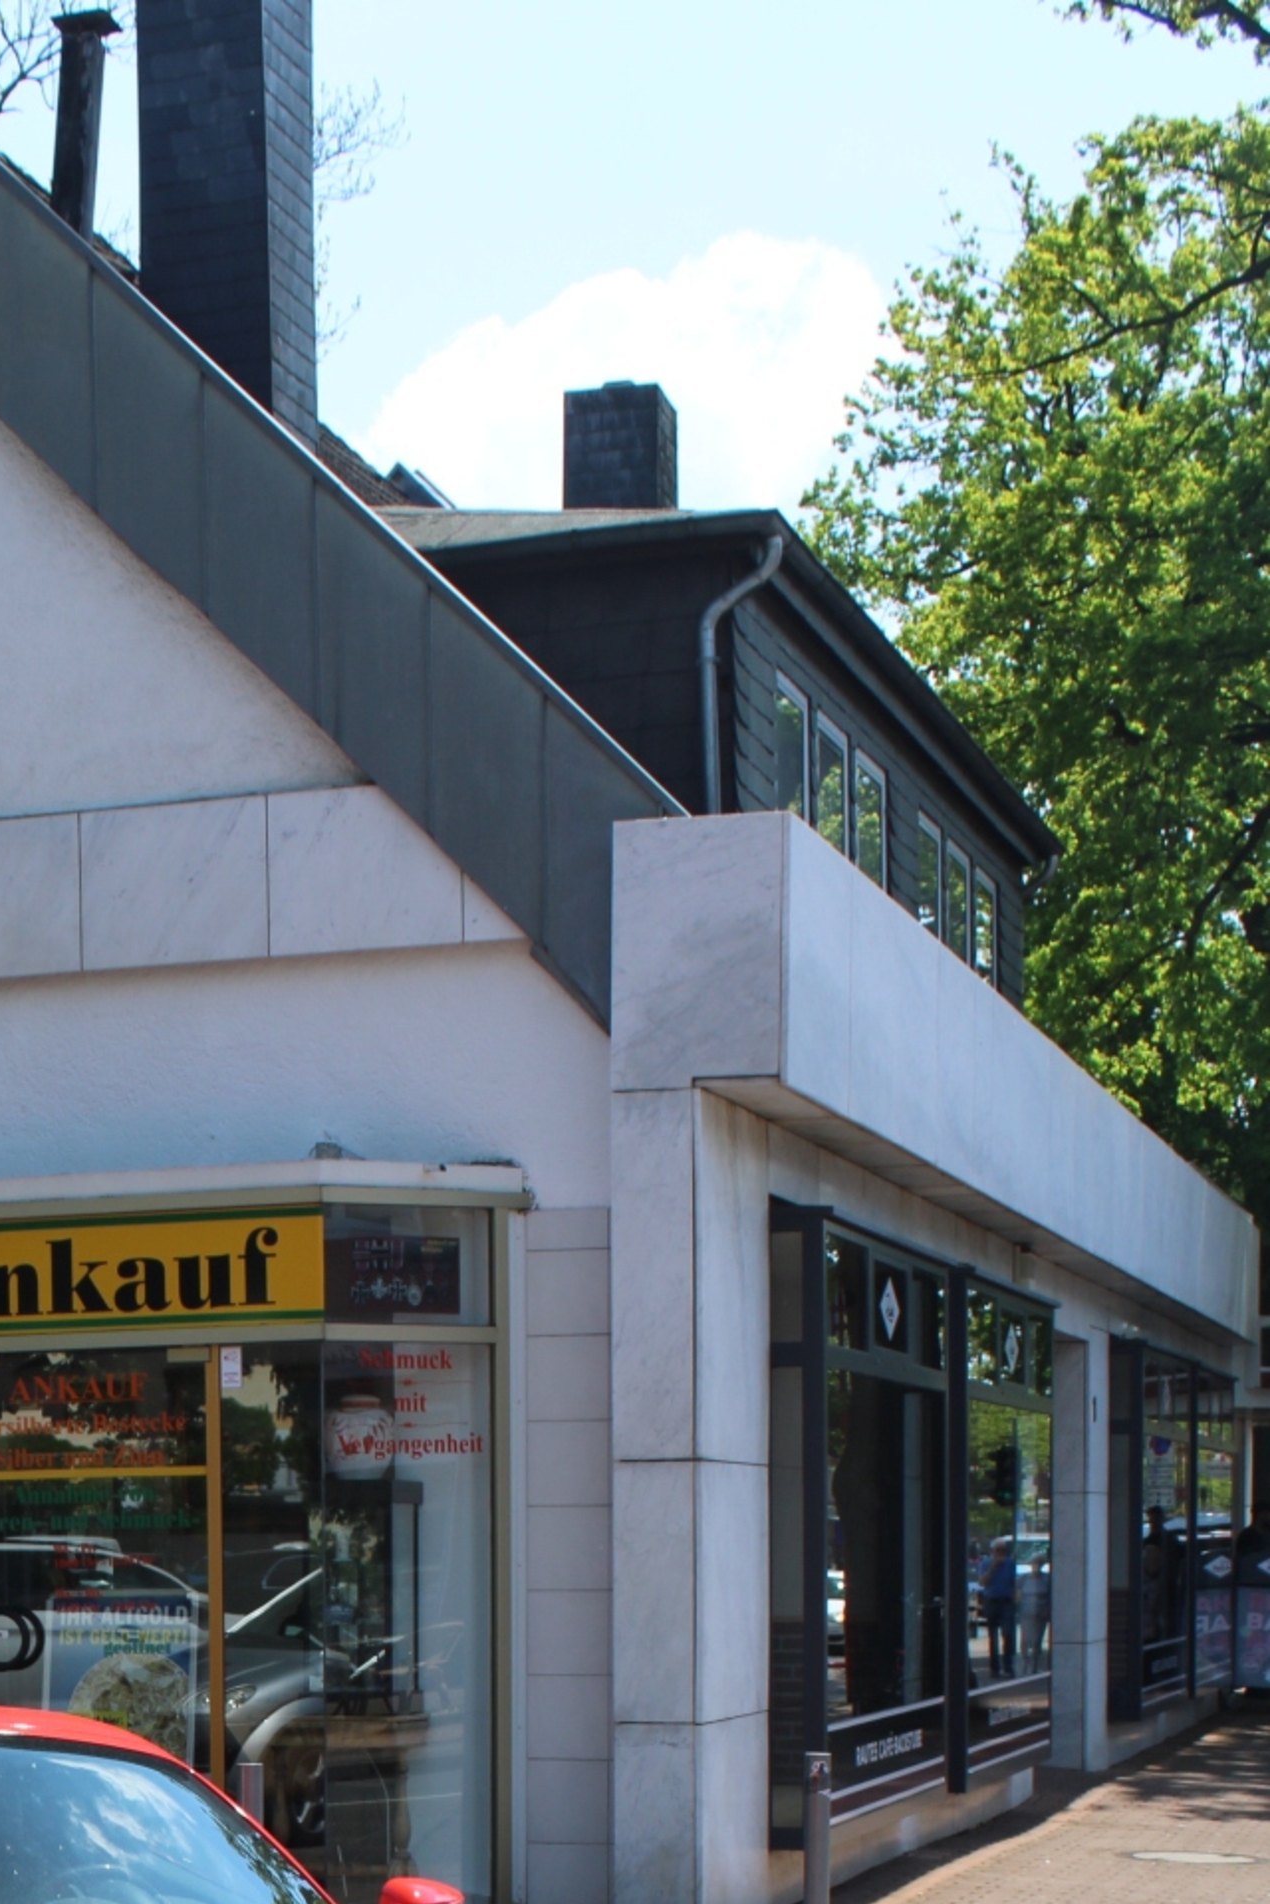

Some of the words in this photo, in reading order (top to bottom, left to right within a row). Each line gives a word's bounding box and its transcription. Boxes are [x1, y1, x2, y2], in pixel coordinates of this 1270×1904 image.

[359, 1348, 452, 1370] Schmuck
[10, 1372, 148, 1404] ANKAUF
[393, 1392, 427, 1412] mit
[91, 1411, 186, 1434] Bestecke
[63, 1446, 105, 1466] und
[113, 1444, 165, 1466] Zinn
[338, 1432, 484, 1460] Vergangenheit
[59, 1605, 94, 1626] IHR
[100, 1605, 189, 1625] ALTGOLD
[58, 1630, 82, 1646] IST
